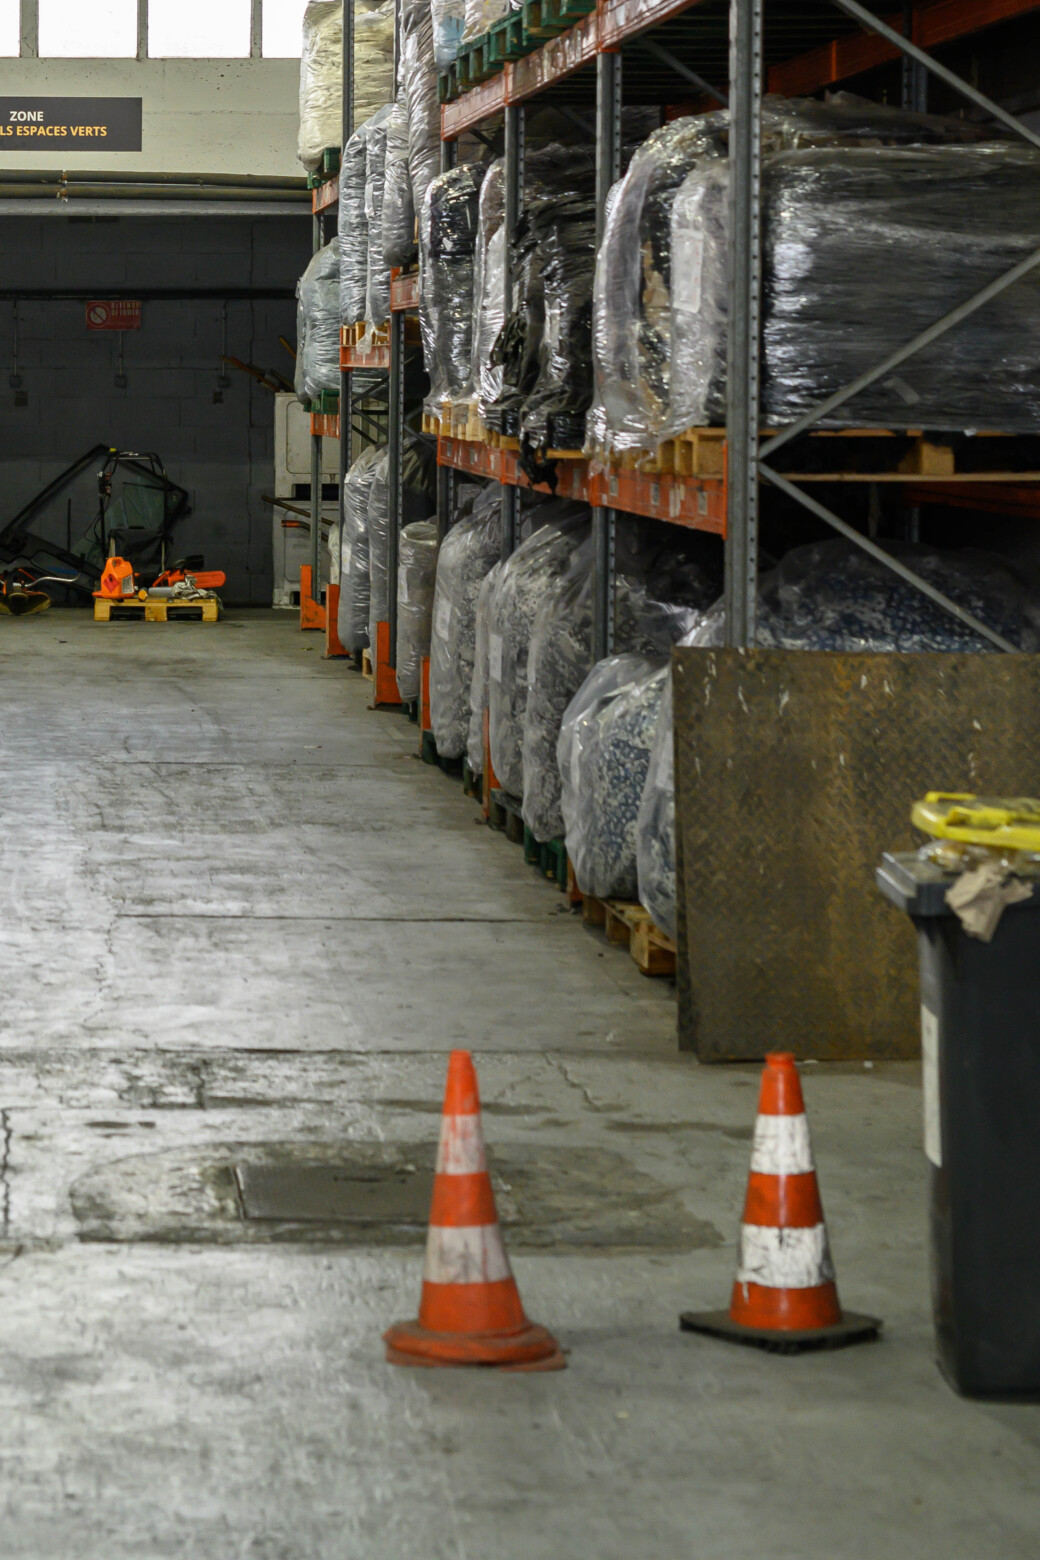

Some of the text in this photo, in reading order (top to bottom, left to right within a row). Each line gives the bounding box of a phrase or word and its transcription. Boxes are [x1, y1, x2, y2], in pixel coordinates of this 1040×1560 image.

[9, 110, 44, 122] ZONE
[16, 125, 67, 137] ESPACES
[69, 125, 107, 137] VERTS
